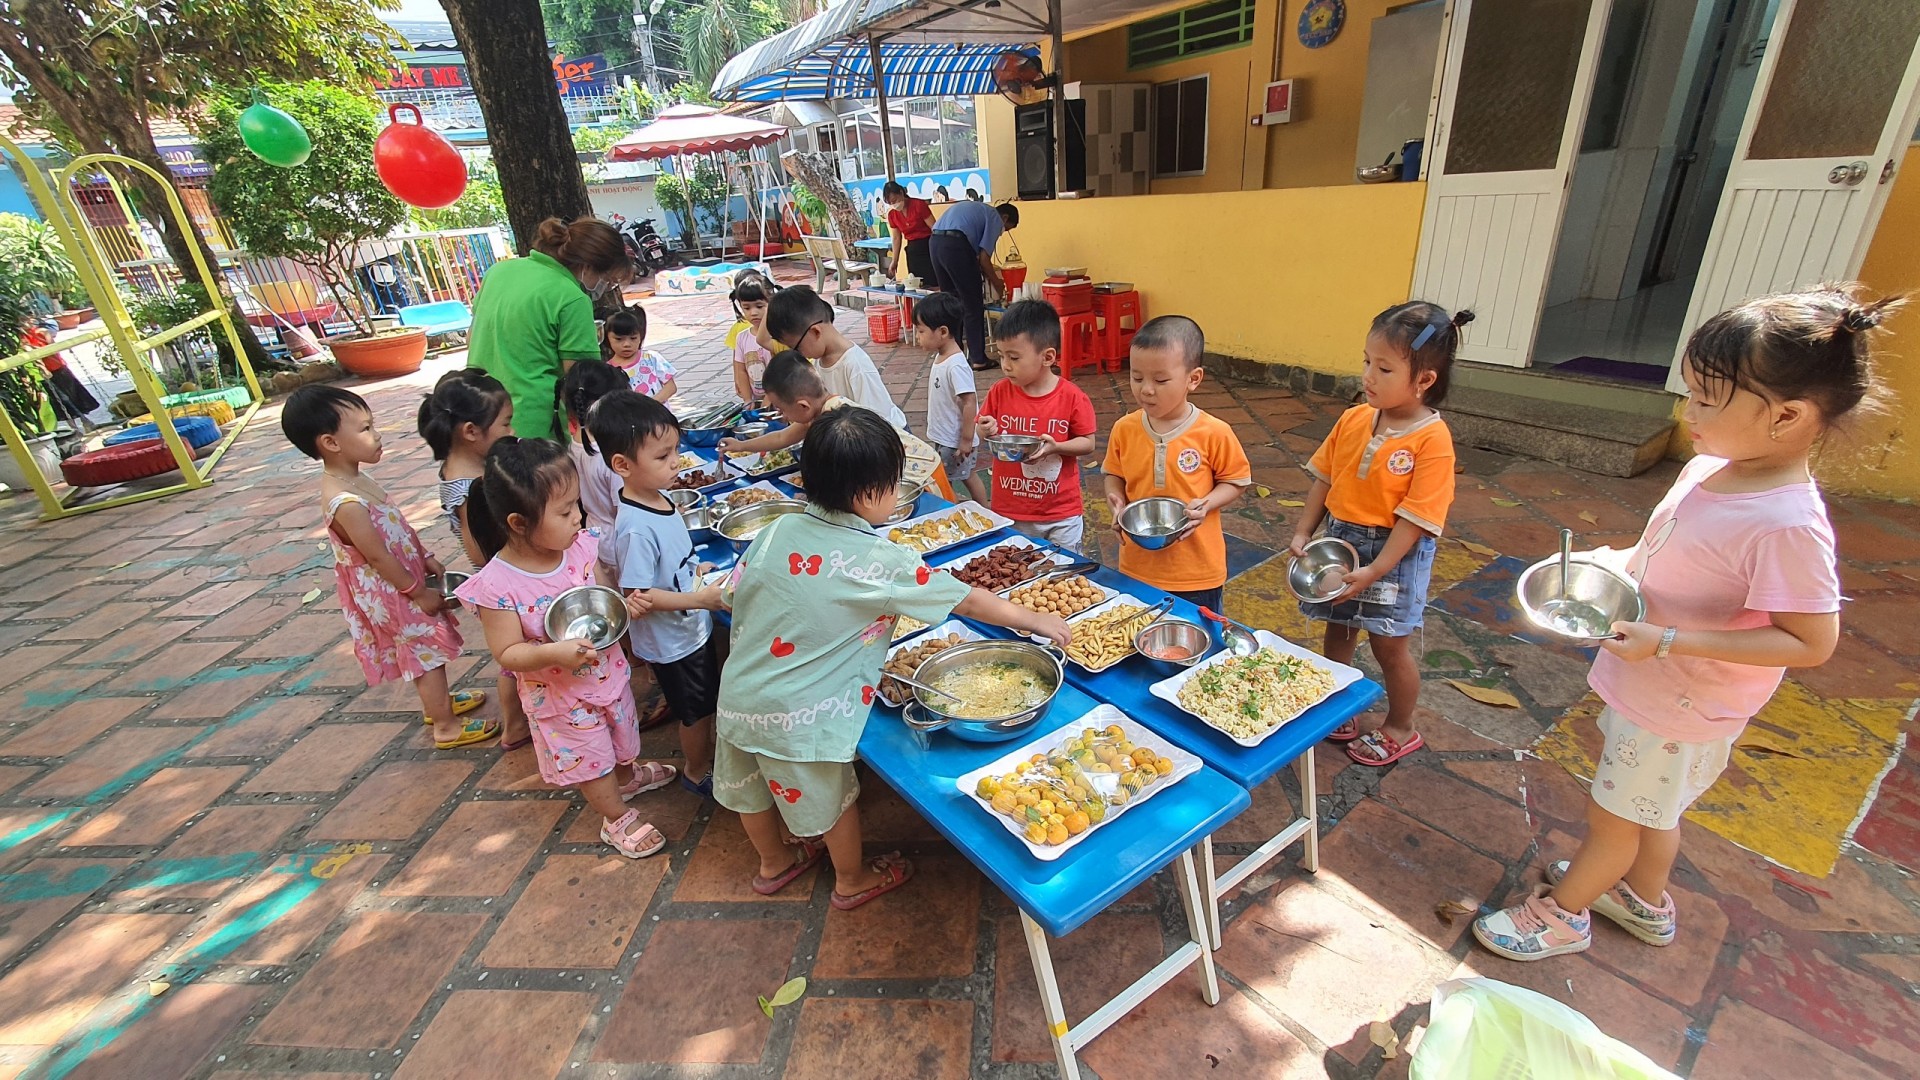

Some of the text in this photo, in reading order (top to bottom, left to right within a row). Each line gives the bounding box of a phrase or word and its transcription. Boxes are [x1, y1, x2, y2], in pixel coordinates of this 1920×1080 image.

[430, 65, 463, 87] ME
[1000, 415, 1070, 434] SMILE IT'S
[999, 476, 1060, 494] WEDNESDAY
